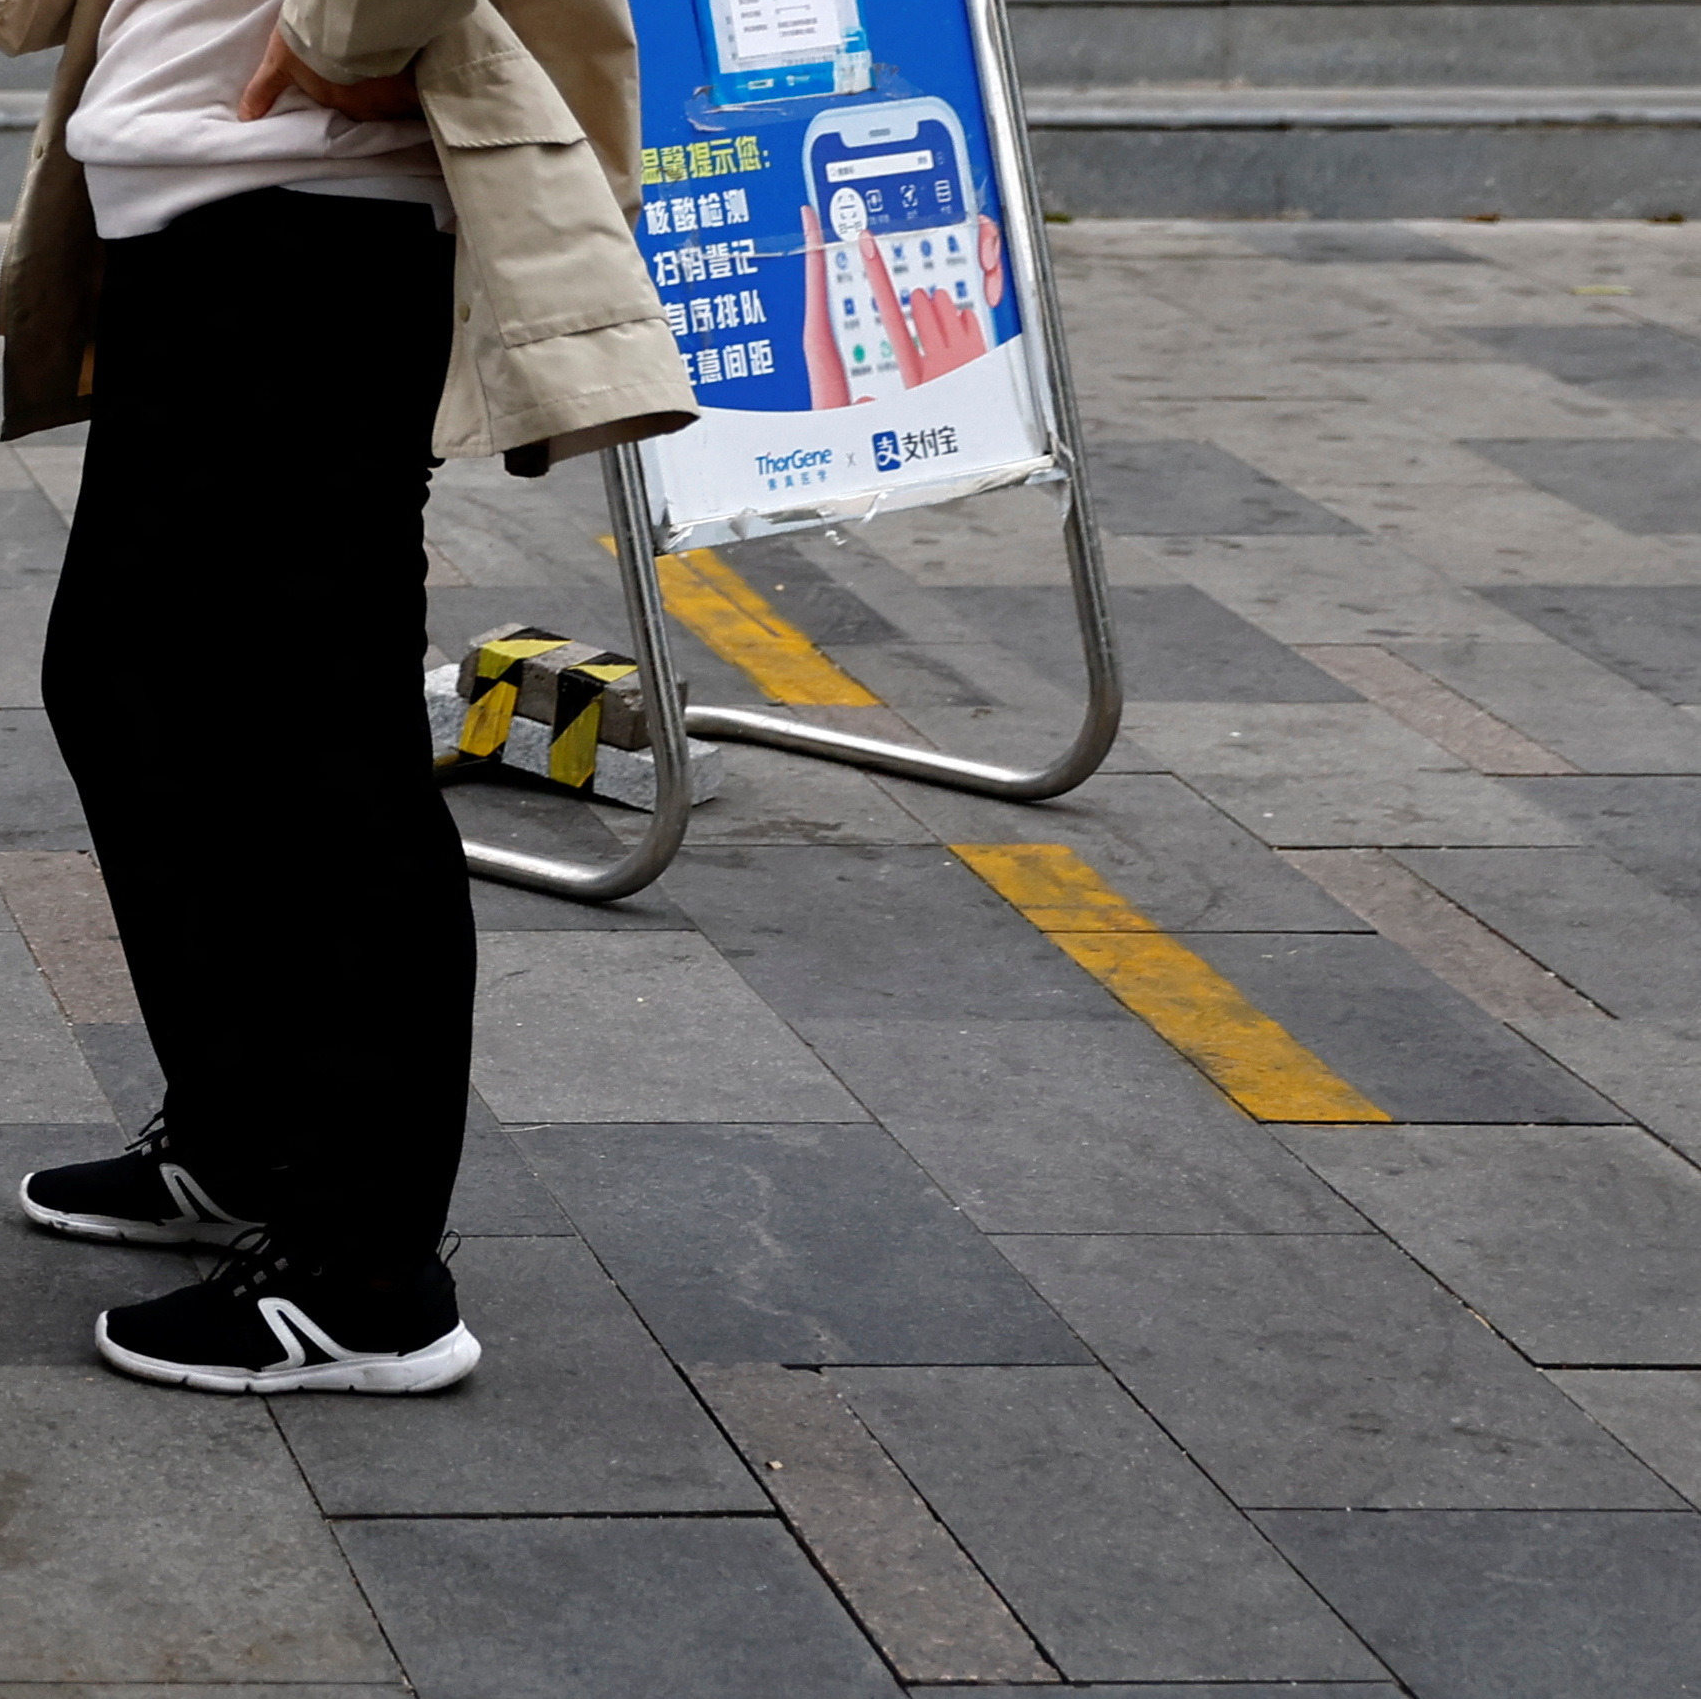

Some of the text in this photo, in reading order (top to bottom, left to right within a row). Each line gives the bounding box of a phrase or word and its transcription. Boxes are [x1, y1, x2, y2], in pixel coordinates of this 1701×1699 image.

[641, 135, 771, 186] 温馨提示您:
[643, 188, 750, 236] 核酸检测
[653, 238, 759, 287] 扫码登记
[664, 289, 767, 337] 有序排队
[755, 448, 833, 476] ThorGene
[900, 425, 959, 463] 支付宝
